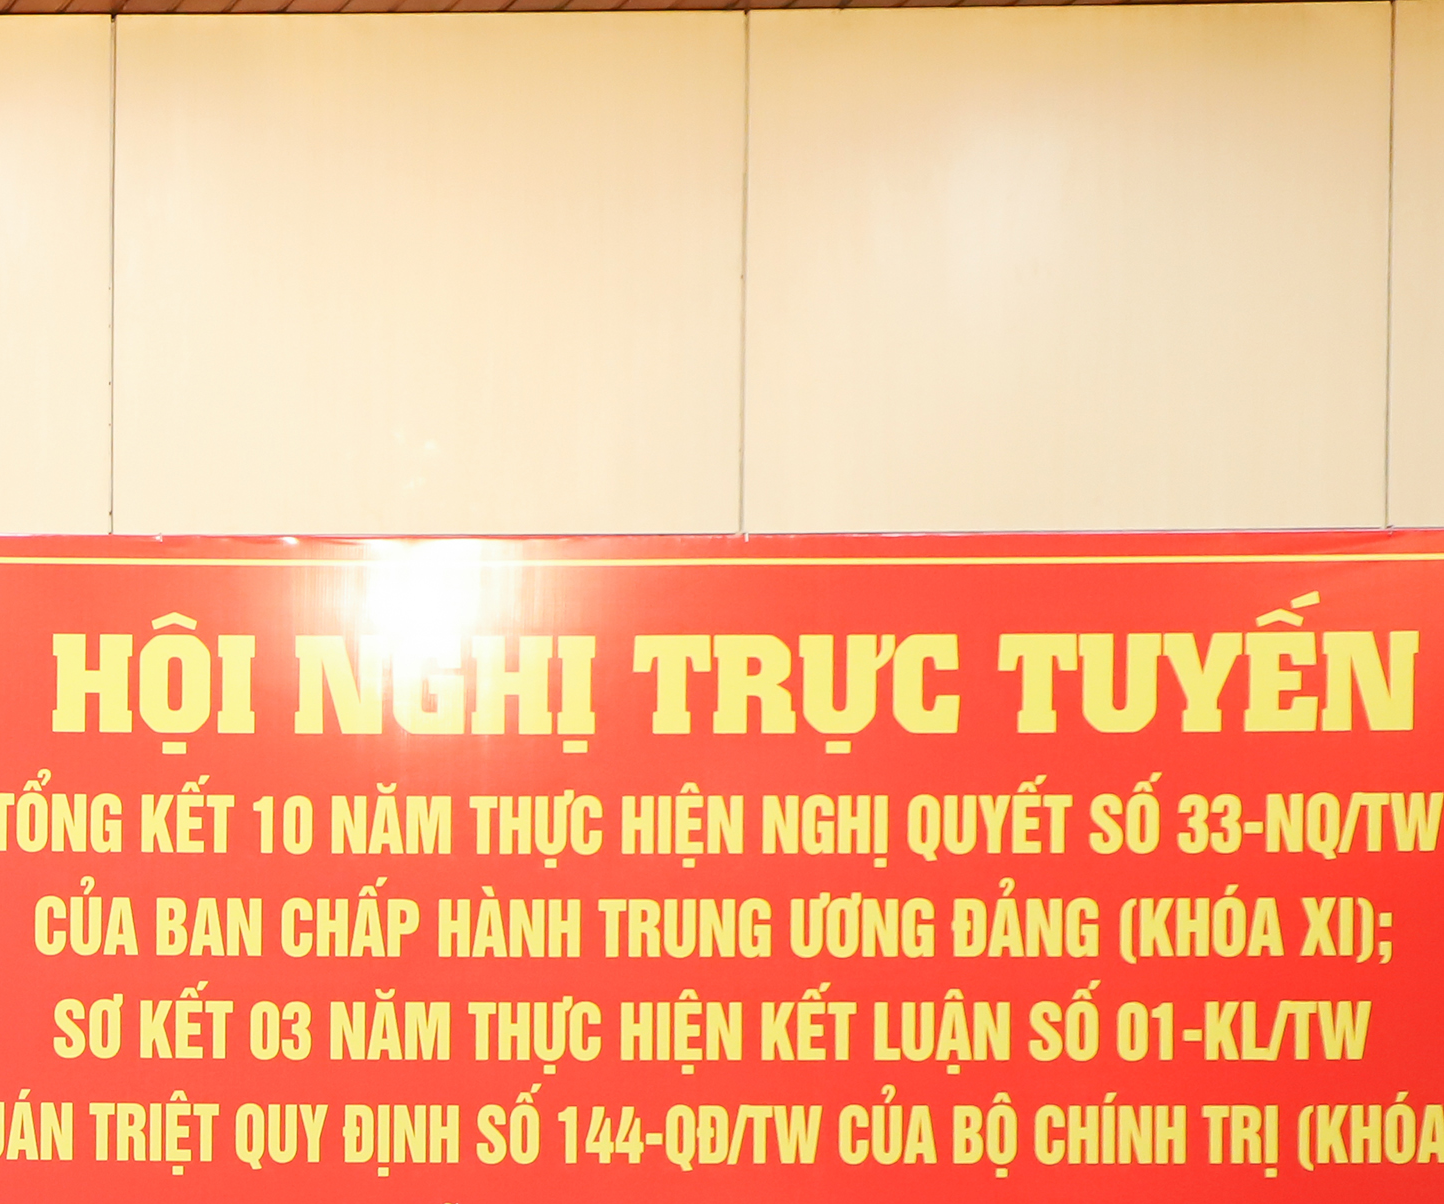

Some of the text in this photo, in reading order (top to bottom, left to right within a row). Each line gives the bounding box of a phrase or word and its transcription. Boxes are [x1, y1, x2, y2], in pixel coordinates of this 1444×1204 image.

[51, 590, 1420, 755] HỘI NGHỊ TRỰC TUYẾN
[140, 774, 236, 854] KẾT
[252, 794, 314, 855] 10
[331, 782, 452, 855] NĂM
[468, 789, 603, 869] THỰC
[621, 781, 744, 869] HIỆN
[762, 794, 889, 868] NGHỊ
[907, 774, 1073, 862] QUYẾT
[1089, 772, 1162, 855] SỐ
[1177, 791, 1444, 860] 33-NQ/TW
[34, 876, 1392, 964] CỦA BAN CHẤP HÀNH TRUNG ƯƠNG ĐẢNG (KHÓA XI);
[53, 979, 1372, 1075] SƠ KẾT 03 NĂM THỰC HIỆN KẾT LUẬN SỐ 01-KL/TW
[88, 1089, 220, 1176] TRIỆT
[235, 1102, 329, 1170] QUY
[342, 1104, 460, 1177] ĐỊNH
[476, 1083, 542, 1165] SỐ
[557, 1104, 823, 1172] 144-QĐ/TW
[838, 1084, 937, 1165] CỦA
[953, 1092, 1018, 1178] BỘ
[1034, 1092, 1187, 1165] CHÍNH
[1202, 1105, 1279, 1178] TRỊ
[1298, 1091, 1444, 1171] (KHÓA
